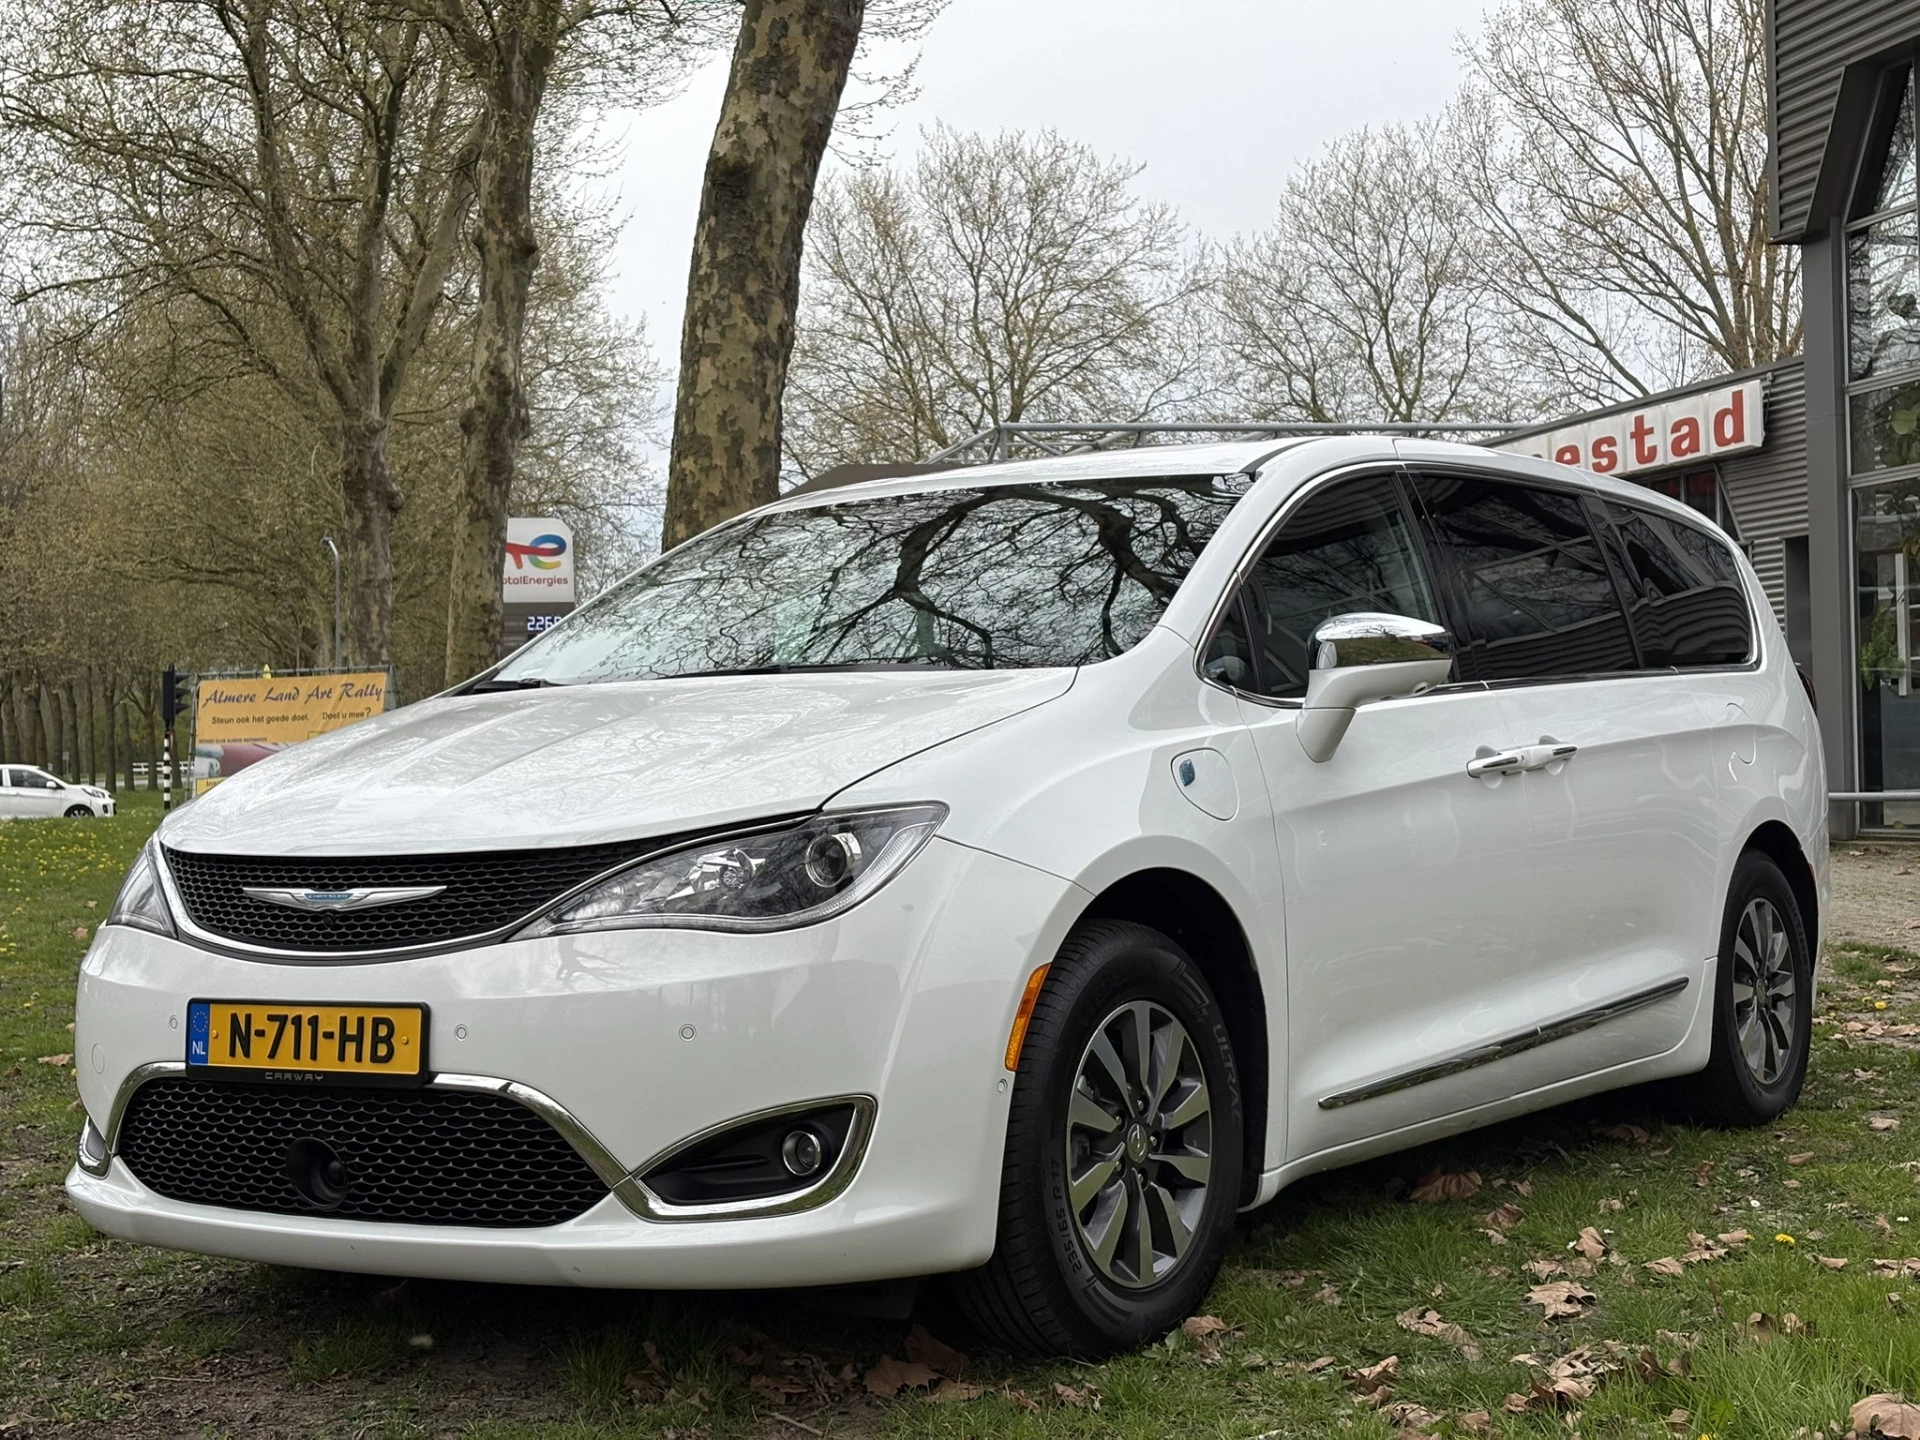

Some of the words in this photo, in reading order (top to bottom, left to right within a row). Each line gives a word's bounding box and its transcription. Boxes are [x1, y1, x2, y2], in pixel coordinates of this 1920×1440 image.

[1531, 389, 1745, 473] estad
[502, 575, 569, 587] otalEnergies
[202, 690, 256, 708] Almere
[263, 686, 300, 703] Land
[304, 685, 333, 704] Art
[339, 682, 385, 701] Rally
[212, 716, 234, 725] Steun
[236, 715, 250, 724] ook
[252, 714, 264, 723] het
[266, 714, 290, 725] goede
[322, 711, 341, 720] Doet
[349, 707, 372, 718] mee?
[229, 1012, 396, 1064] N-711-HB
[192, 1041, 206, 1056] NL
[265, 1072, 324, 1081] CARWAY
